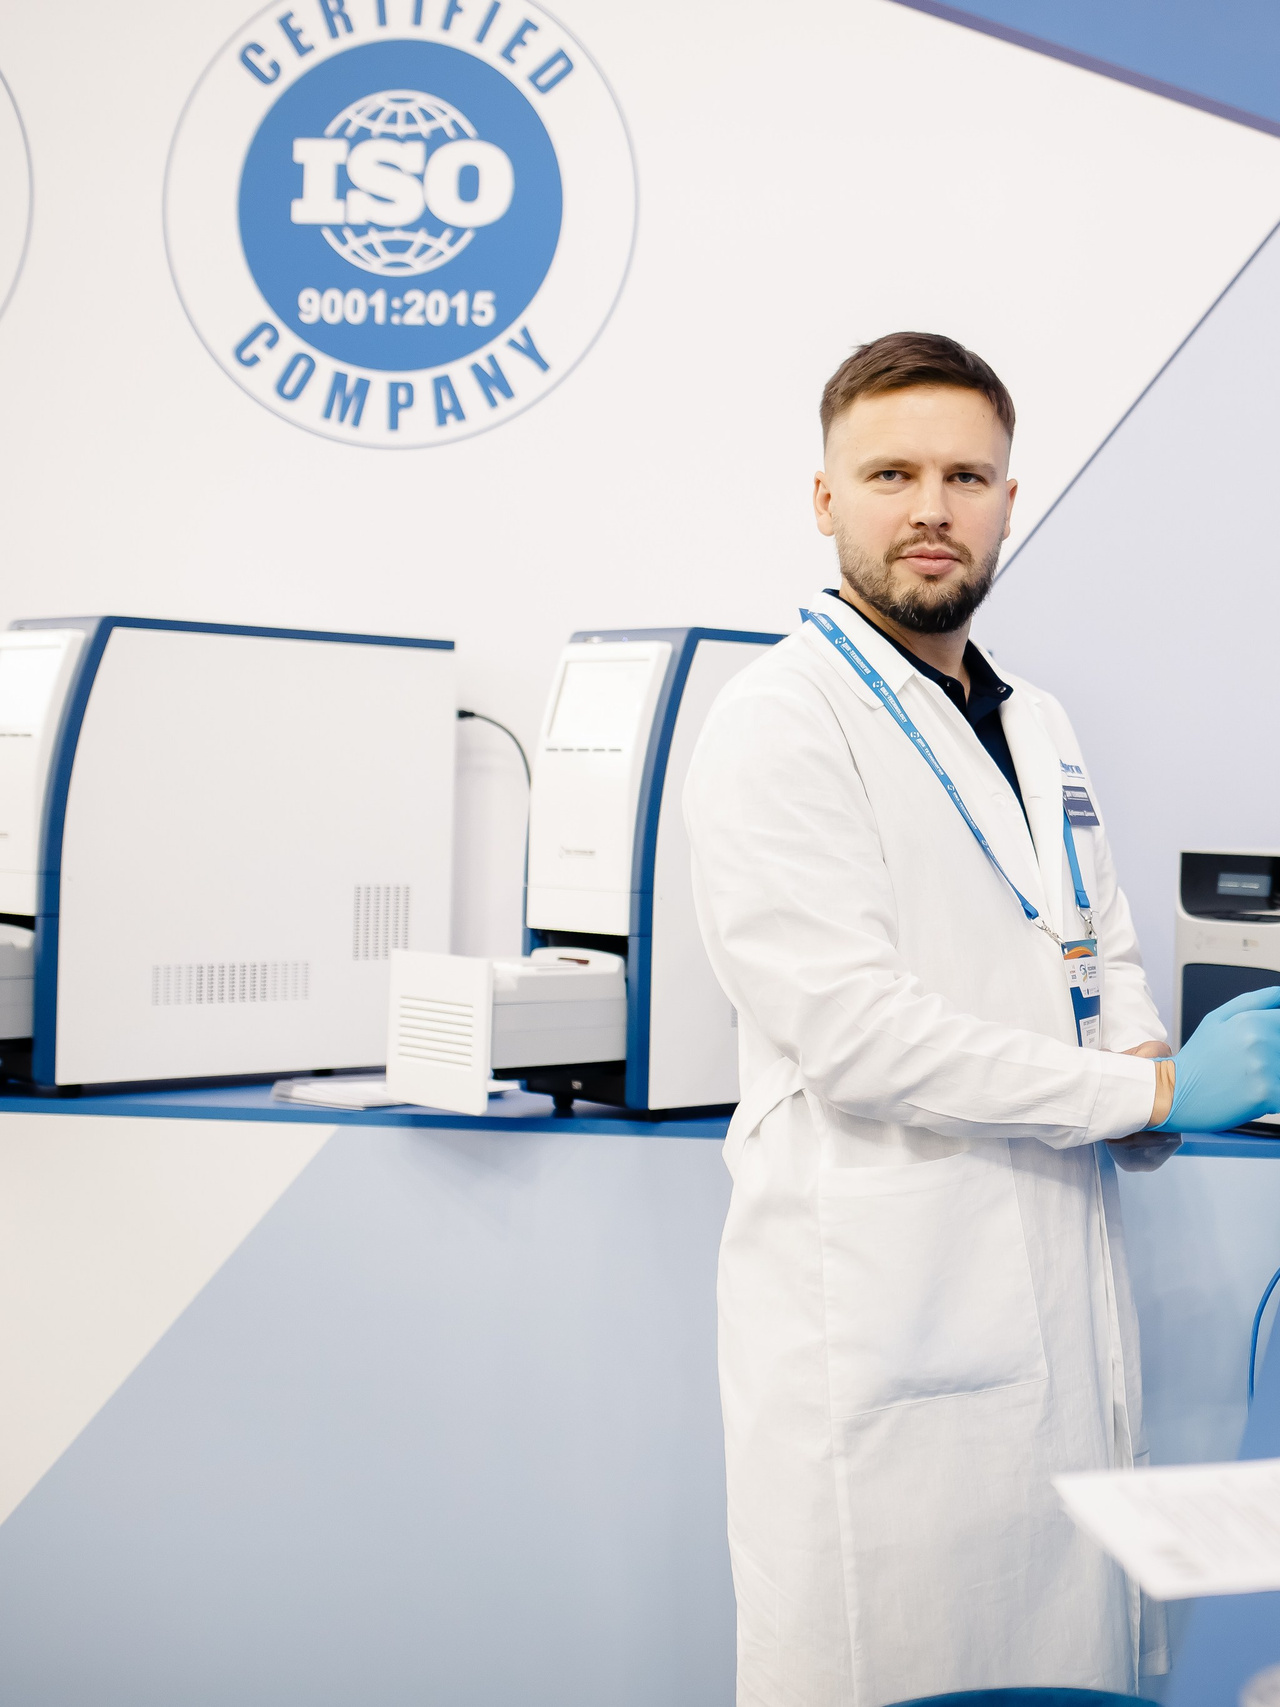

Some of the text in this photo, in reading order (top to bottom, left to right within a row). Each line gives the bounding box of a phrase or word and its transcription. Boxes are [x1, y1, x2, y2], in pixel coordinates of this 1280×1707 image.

[291, 137, 515, 229] ISO
[298, 287, 497, 328] 9001:2015
[233, 322, 551, 431] COMPANY
